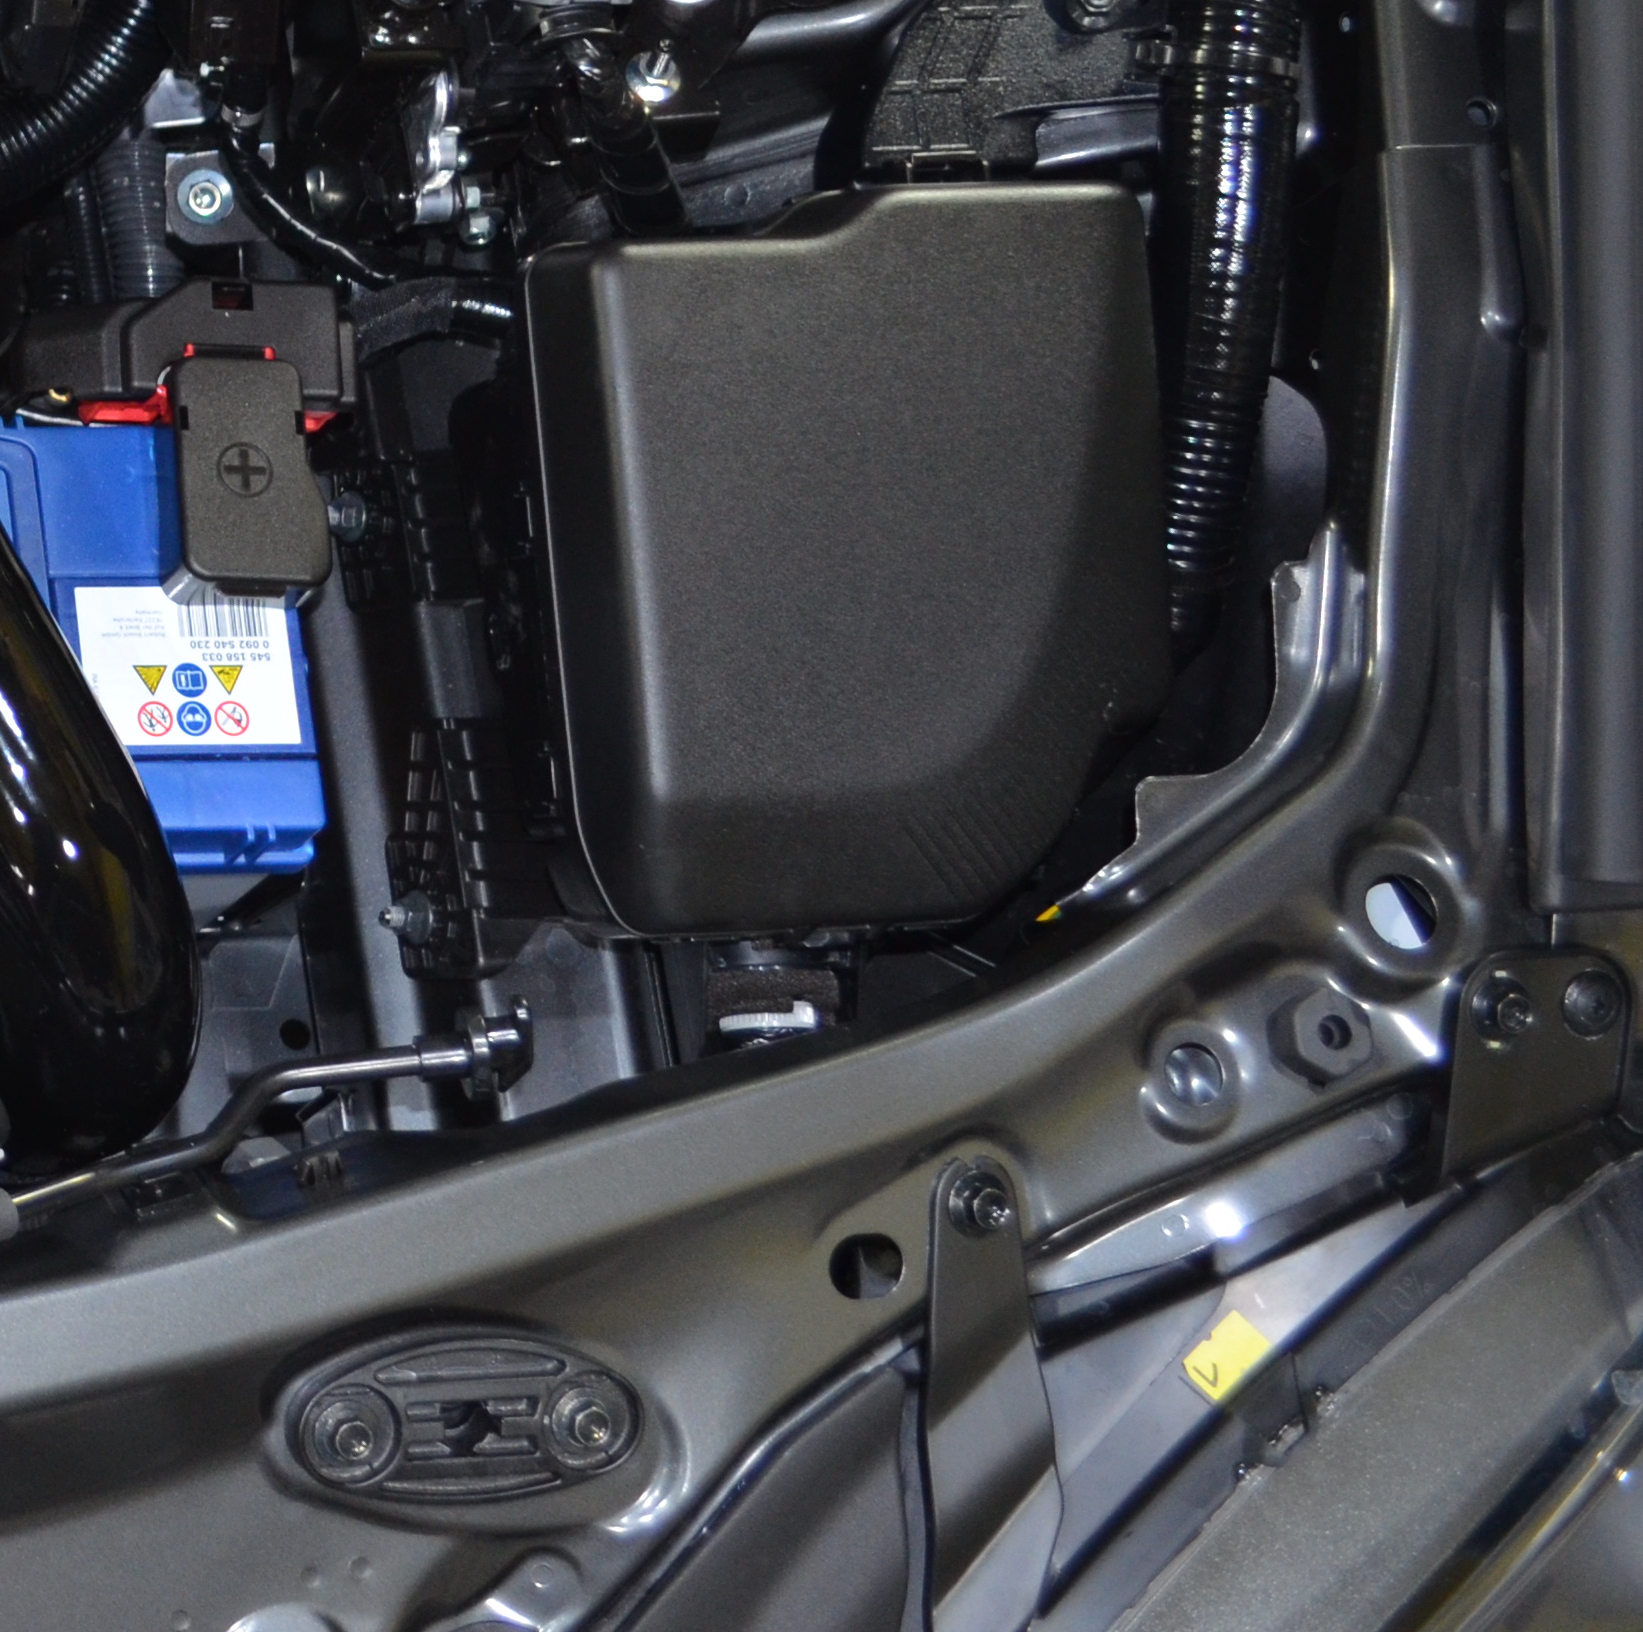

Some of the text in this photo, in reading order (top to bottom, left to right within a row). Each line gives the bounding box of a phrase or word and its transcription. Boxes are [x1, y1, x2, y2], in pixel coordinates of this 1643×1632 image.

[190, 640, 210, 649] 230
[239, 640, 259, 649] 092
[263, 640, 269, 649] 0
[201, 652, 271, 662] 545 158 033
